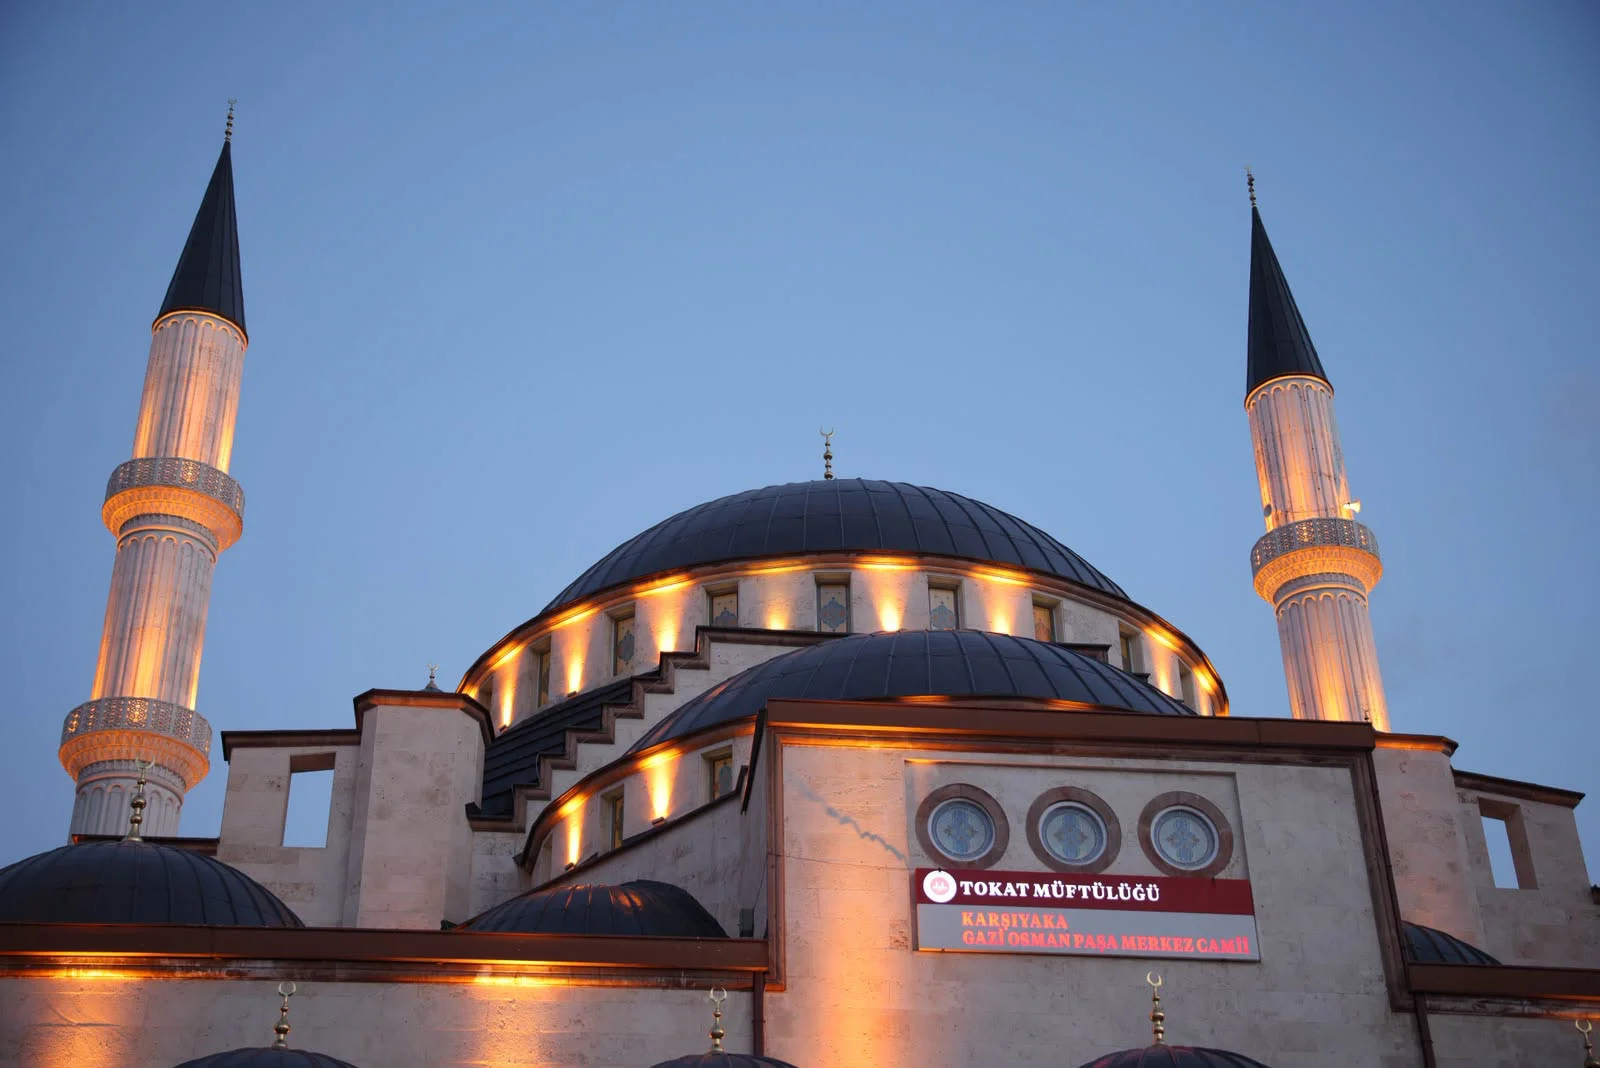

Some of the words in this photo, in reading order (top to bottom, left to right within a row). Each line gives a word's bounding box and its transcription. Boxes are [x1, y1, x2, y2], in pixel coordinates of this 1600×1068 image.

[960, 881, 1030, 897] TOKAT
[1033, 880, 1160, 901] MÜFTÜLÜĞÜ
[961, 911, 1069, 931] KARŞIYAKA
[962, 928, 1006, 945] GAZİ
[1007, 931, 1071, 948] OSMAN
[1073, 933, 1119, 952] PAŞA
[1121, 935, 1194, 953] MERKEZ
[1196, 936, 1250, 954] CAMİİ
